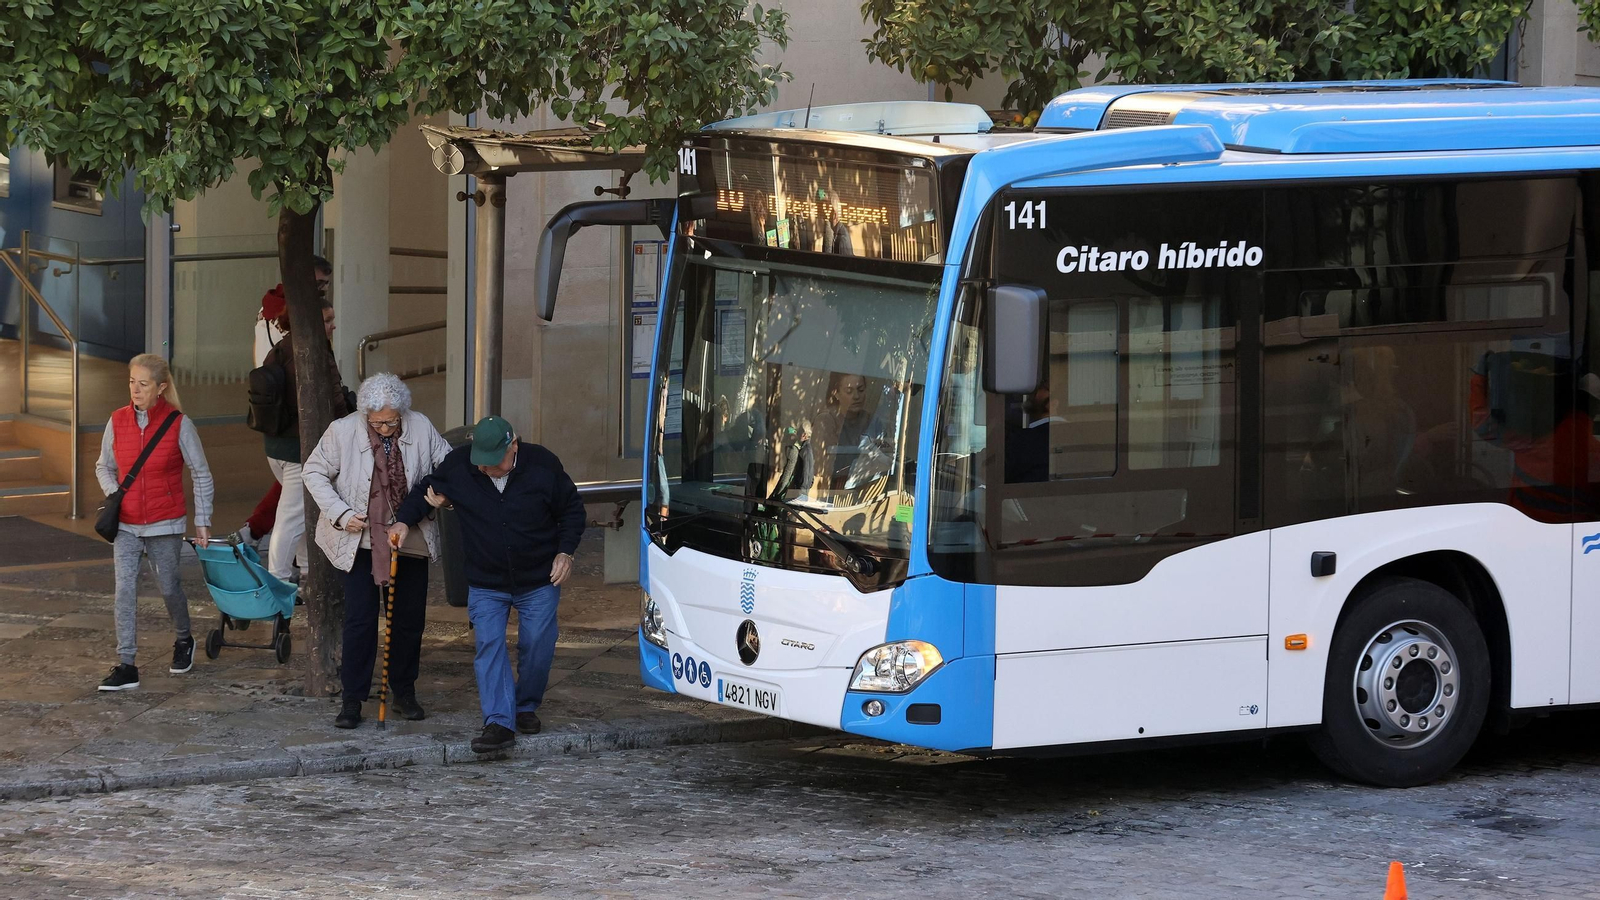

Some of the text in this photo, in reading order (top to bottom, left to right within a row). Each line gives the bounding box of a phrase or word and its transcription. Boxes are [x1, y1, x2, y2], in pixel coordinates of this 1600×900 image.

[677, 147, 697, 176] 141
[822, 203, 833, 221] y
[837, 202, 889, 225] Gasset
[1004, 200, 1046, 230] 141
[1056, 240, 1263, 274] Citaro híbrido
[781, 638, 815, 651] CITARO
[725, 683, 777, 711] 4821 NGV
